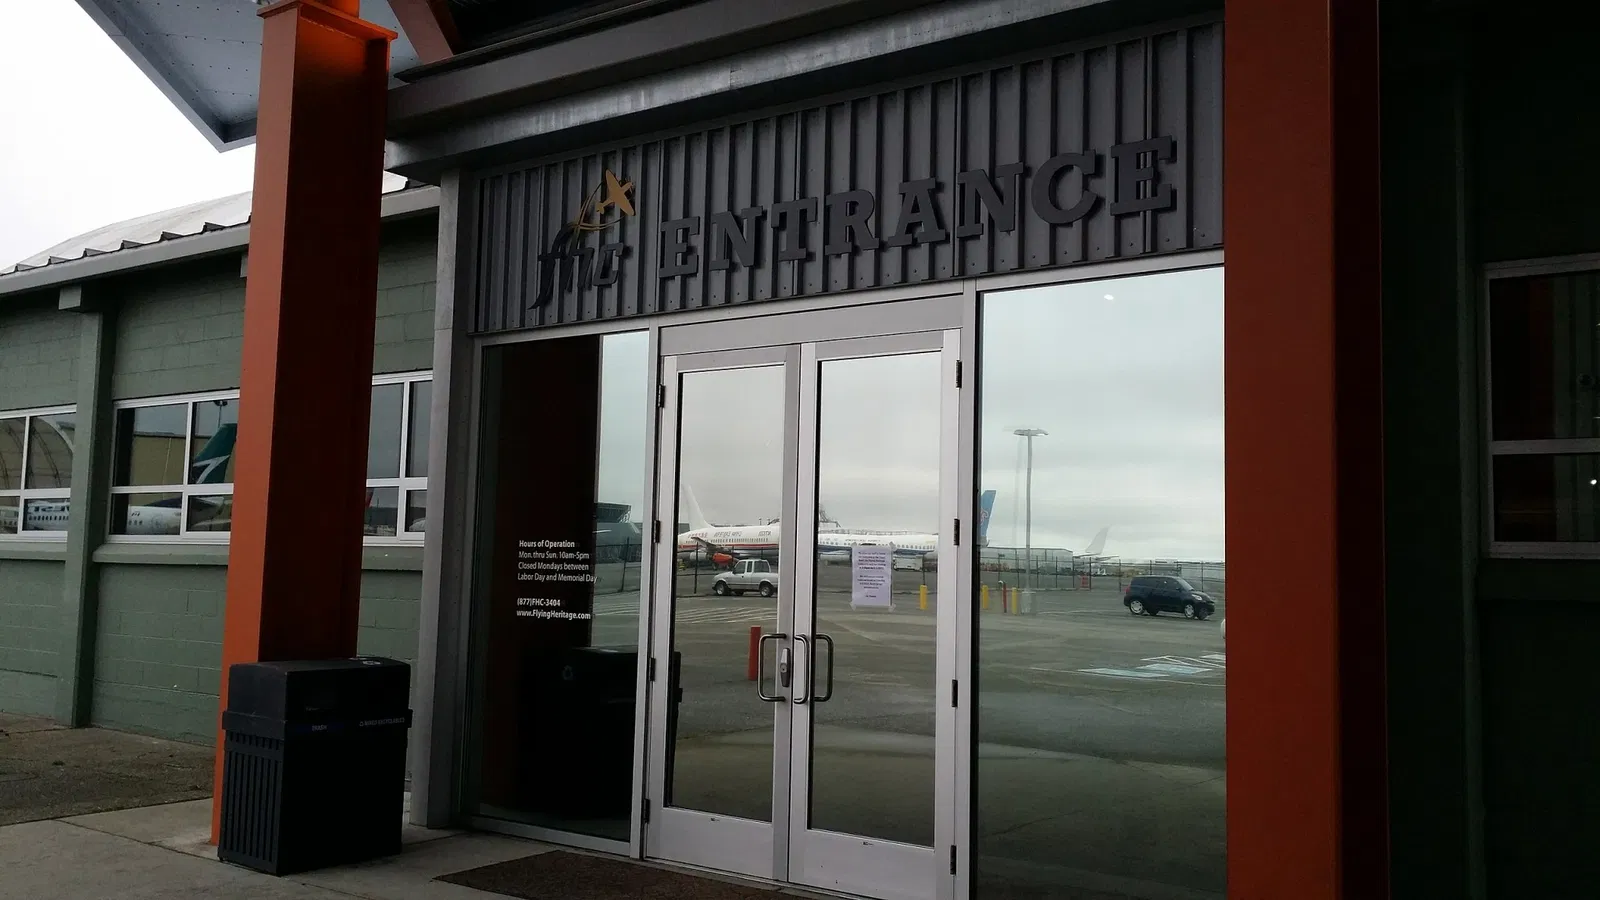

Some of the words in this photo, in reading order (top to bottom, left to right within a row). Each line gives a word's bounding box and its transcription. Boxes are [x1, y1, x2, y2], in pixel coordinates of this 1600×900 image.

[659, 136, 1173, 278] ENTRANCE
[519, 540, 536, 548] Hours
[537, 540, 544, 548] of
[545, 540, 575, 549] Operation
[533, 551, 545, 559] thru
[546, 551, 558, 559] Sun.
[559, 551, 589, 560] 10am-5pm
[518, 562, 536, 570] Closed
[538, 562, 563, 571] Mondays
[564, 562, 589, 570] between
[518, 573, 533, 581] Labor
[535, 573, 545, 582] Day
[546, 573, 557, 581] and
[558, 574, 584, 582] Memorial
[586, 574, 597, 583] Day
[516, 609, 591, 620] www.FlyingHeritage.com
